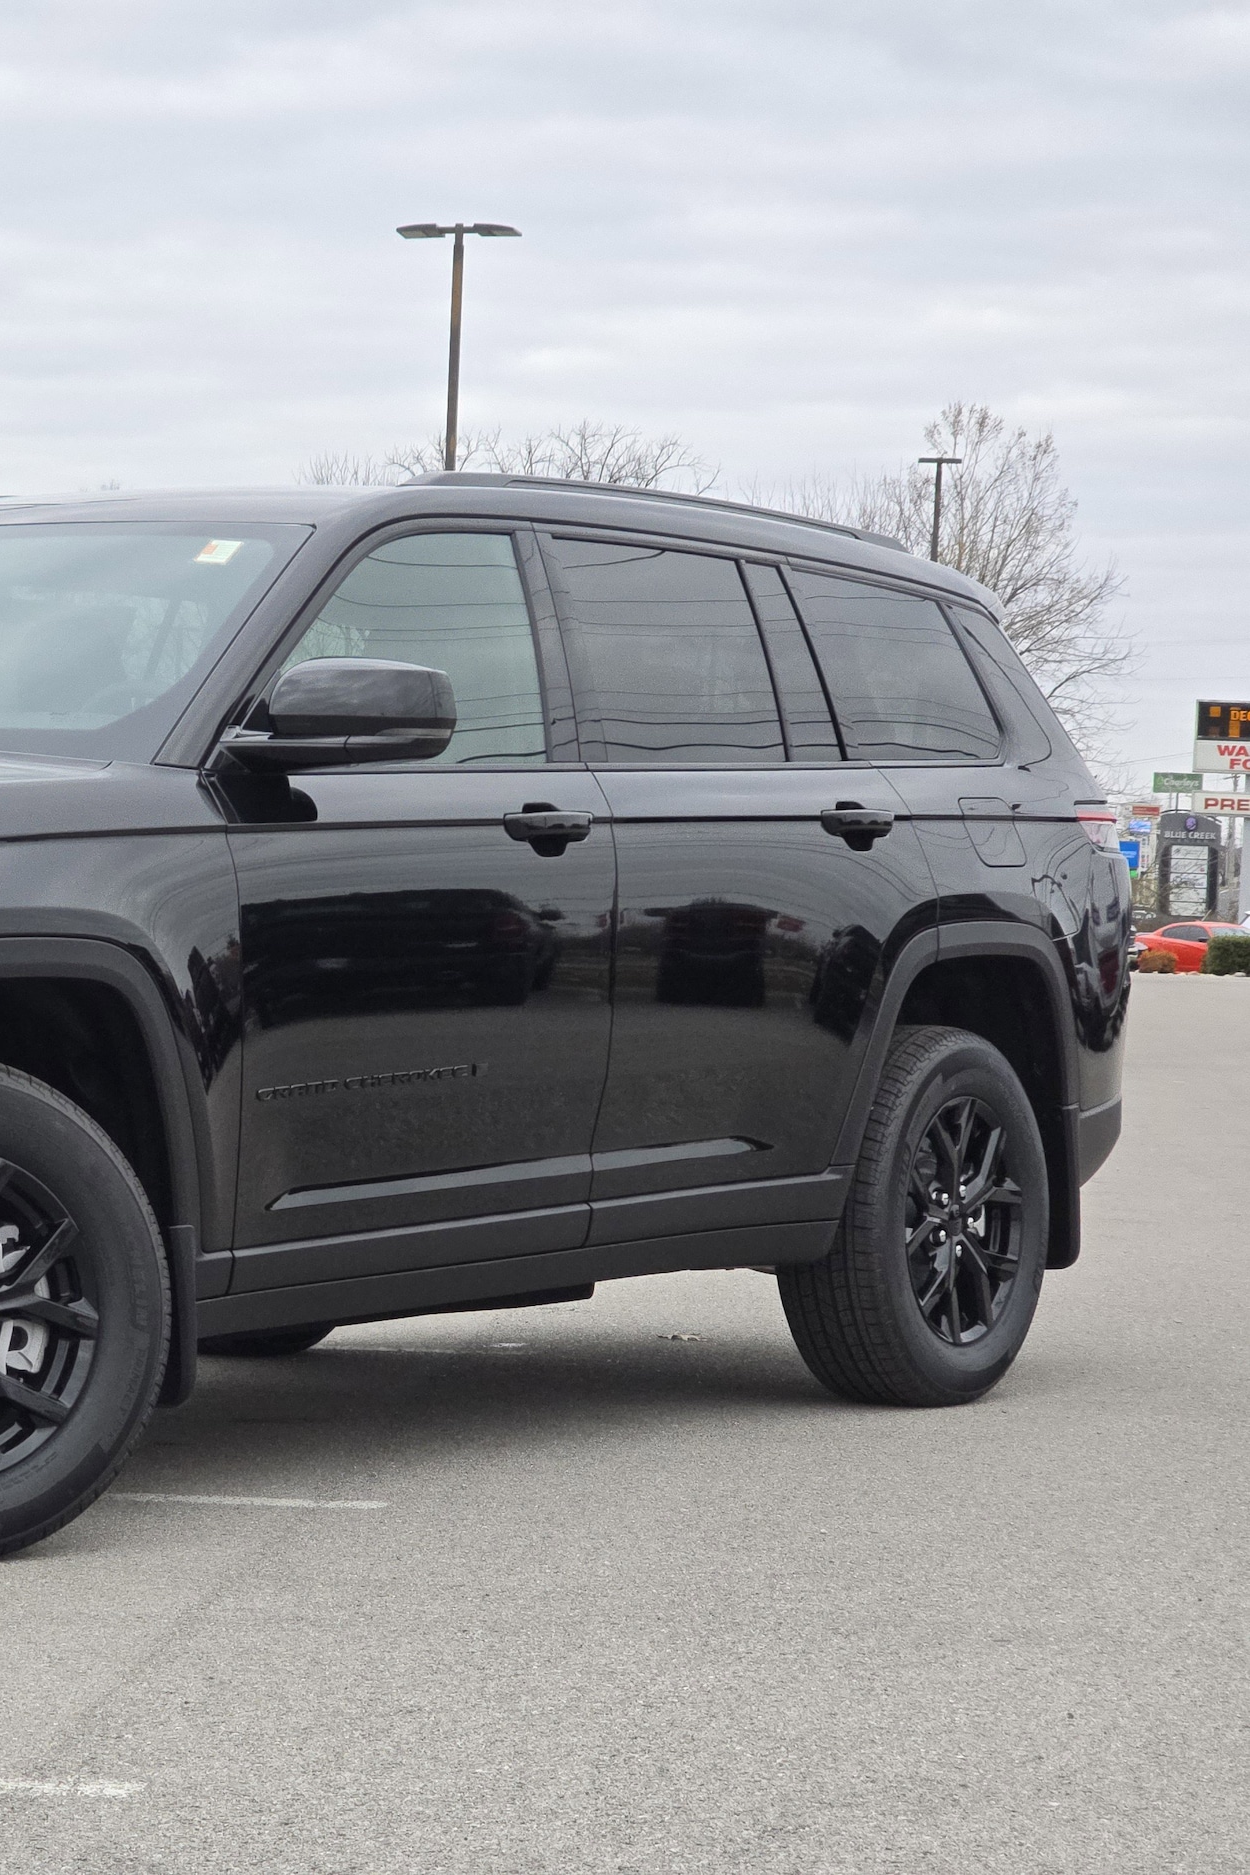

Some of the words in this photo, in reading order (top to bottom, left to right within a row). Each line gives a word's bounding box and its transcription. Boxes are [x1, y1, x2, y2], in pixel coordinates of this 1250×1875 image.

[1164, 831, 1187, 839] BLUE
[1188, 831, 1216, 840] CREEK
[344, 1064, 469, 1090] CHEROKEE
